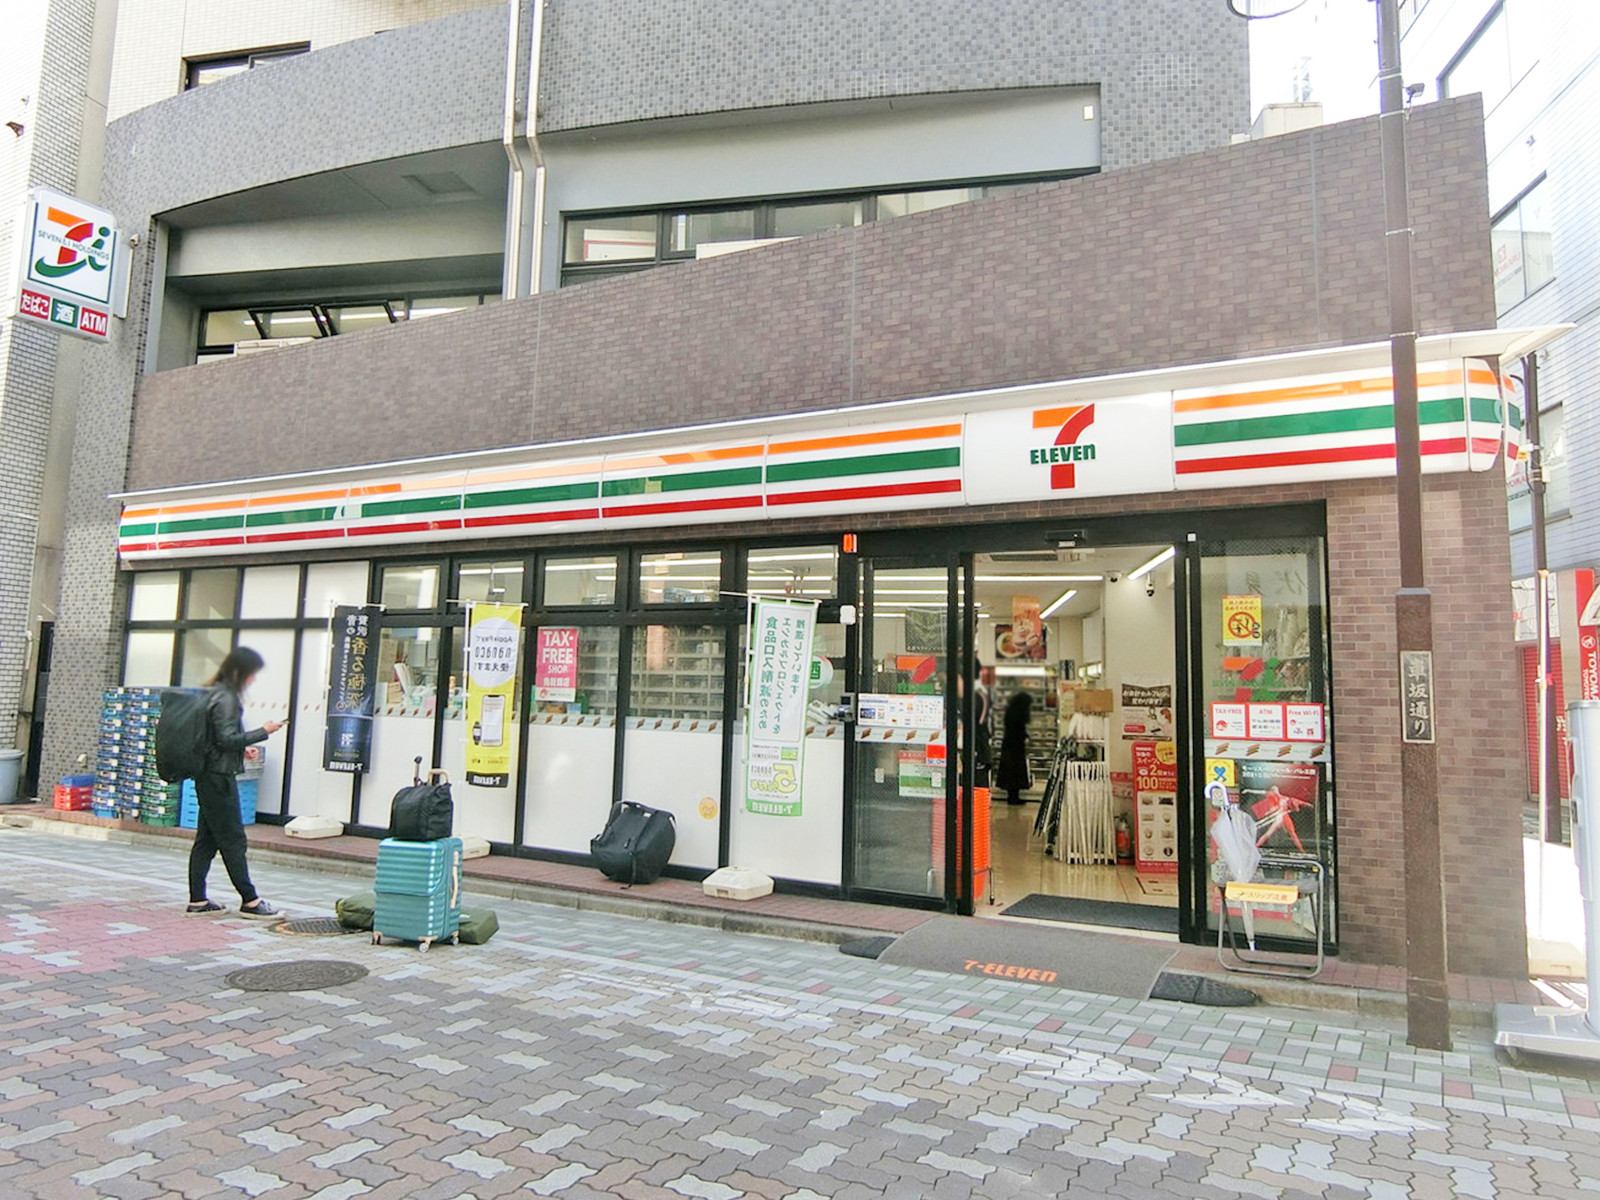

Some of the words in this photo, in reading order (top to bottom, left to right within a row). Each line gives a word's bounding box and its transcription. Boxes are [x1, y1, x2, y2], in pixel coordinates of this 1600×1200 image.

[72, 242, 110, 261] HOLDINGS
[22, 292, 49, 316] たばこ
[55, 303, 75, 323] 酒
[81, 311, 107, 332] ATM
[543, 631, 574, 646] TAX-
[542, 648, 574, 664] FREE
[547, 665, 569, 674] SHOP
[1408, 658, 1429, 737] 車坂通り
[1136, 776, 1159, 790] 100
